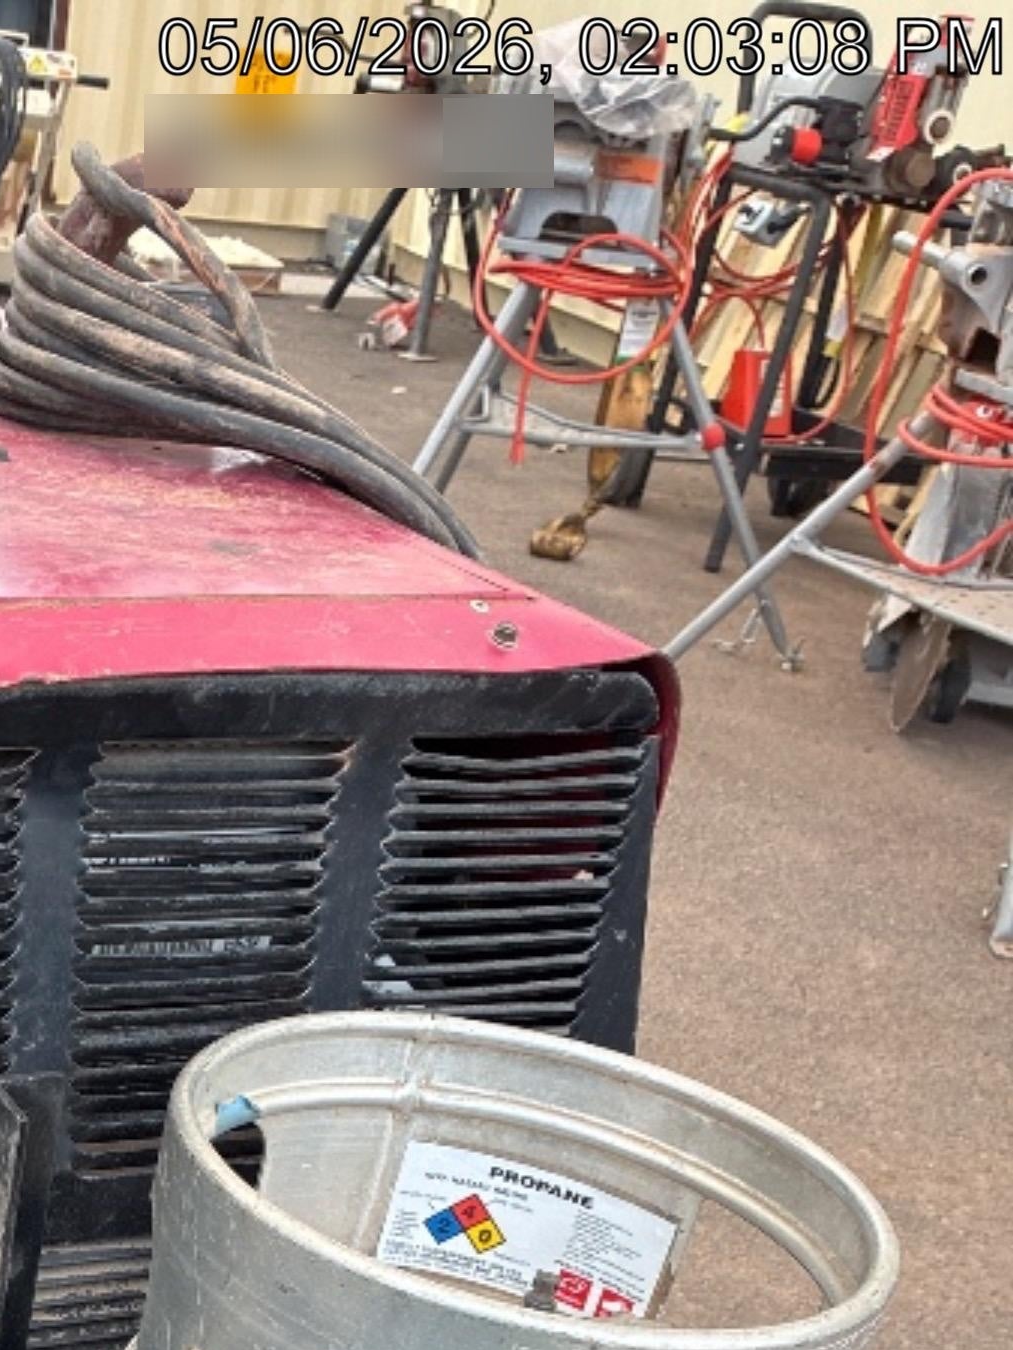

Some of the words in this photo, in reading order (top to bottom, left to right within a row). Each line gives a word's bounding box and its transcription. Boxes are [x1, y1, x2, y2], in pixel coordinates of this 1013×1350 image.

[490, 1165, 596, 1209] PROPANE
[437, 1217, 451, 1235] 2
[477, 1229, 493, 1246] 0
